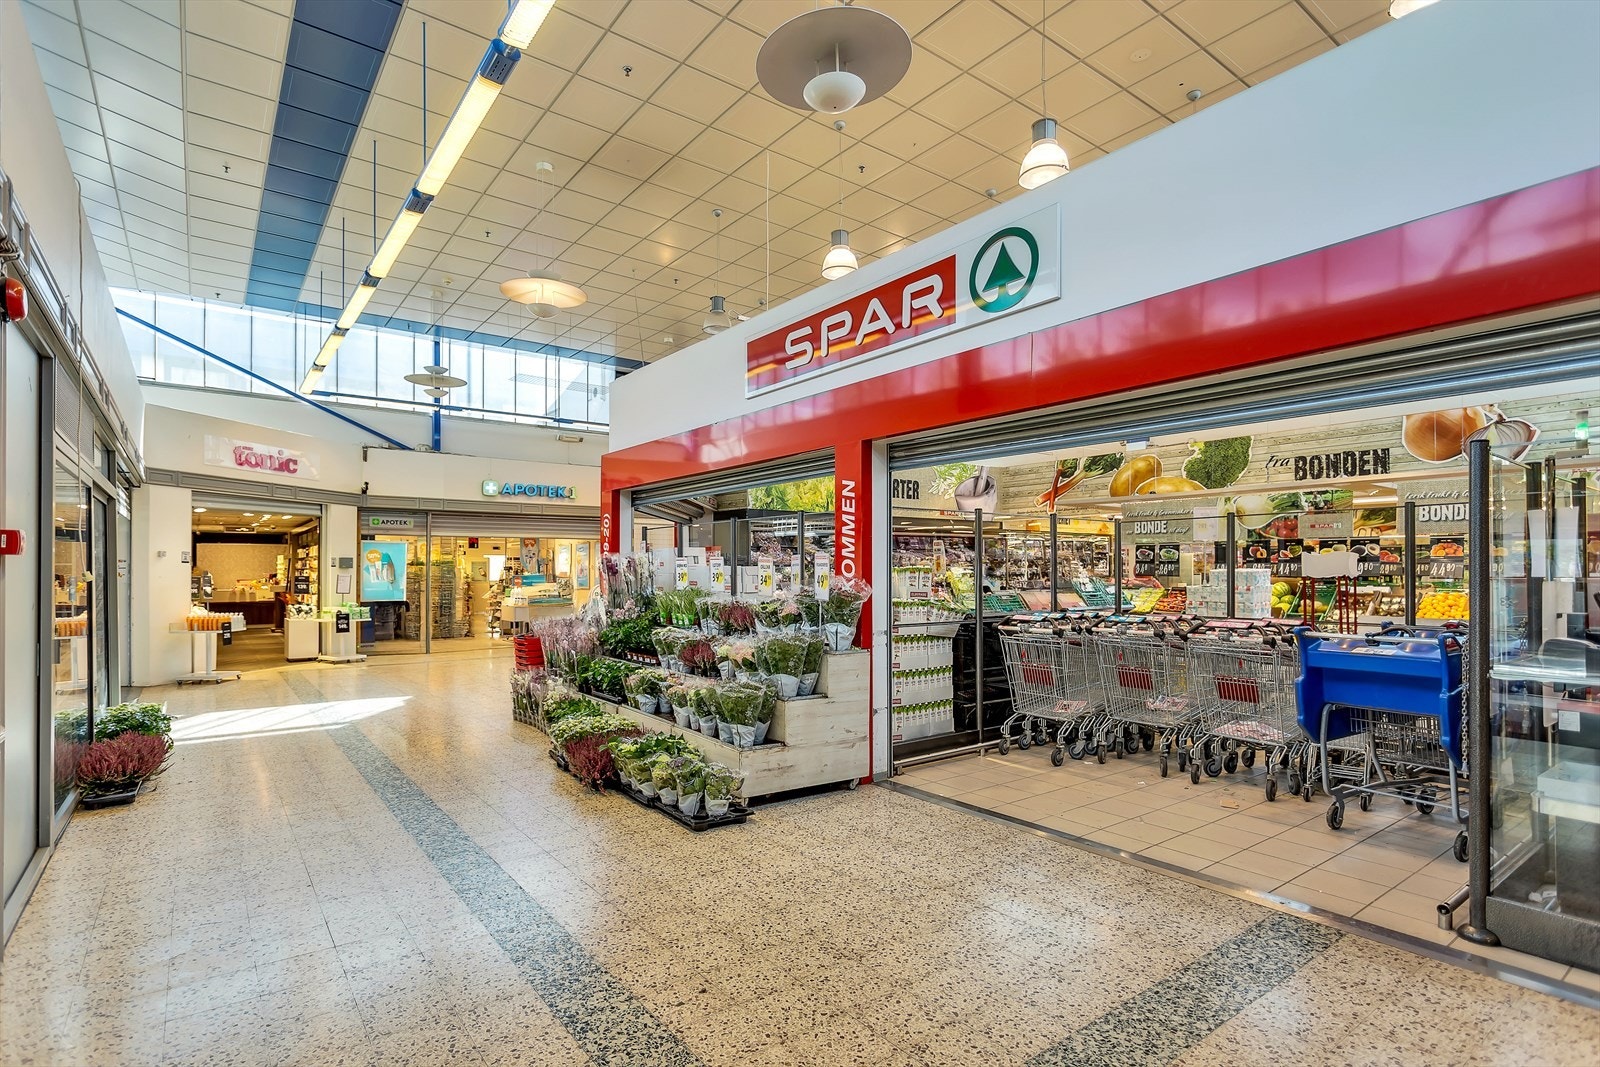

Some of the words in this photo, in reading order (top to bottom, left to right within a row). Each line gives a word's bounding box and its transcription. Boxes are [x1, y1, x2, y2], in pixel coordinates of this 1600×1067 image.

[784, 273, 945, 370] SPAR
[233, 446, 298, 474] tonic
[1293, 447, 1391, 481] BONDEN
[501, 483, 567, 499] APOTEK
[380, 518, 408, 526] APOTEK
[1418, 504, 1469, 522] BOND
[1134, 521, 1168, 534] BONDE
